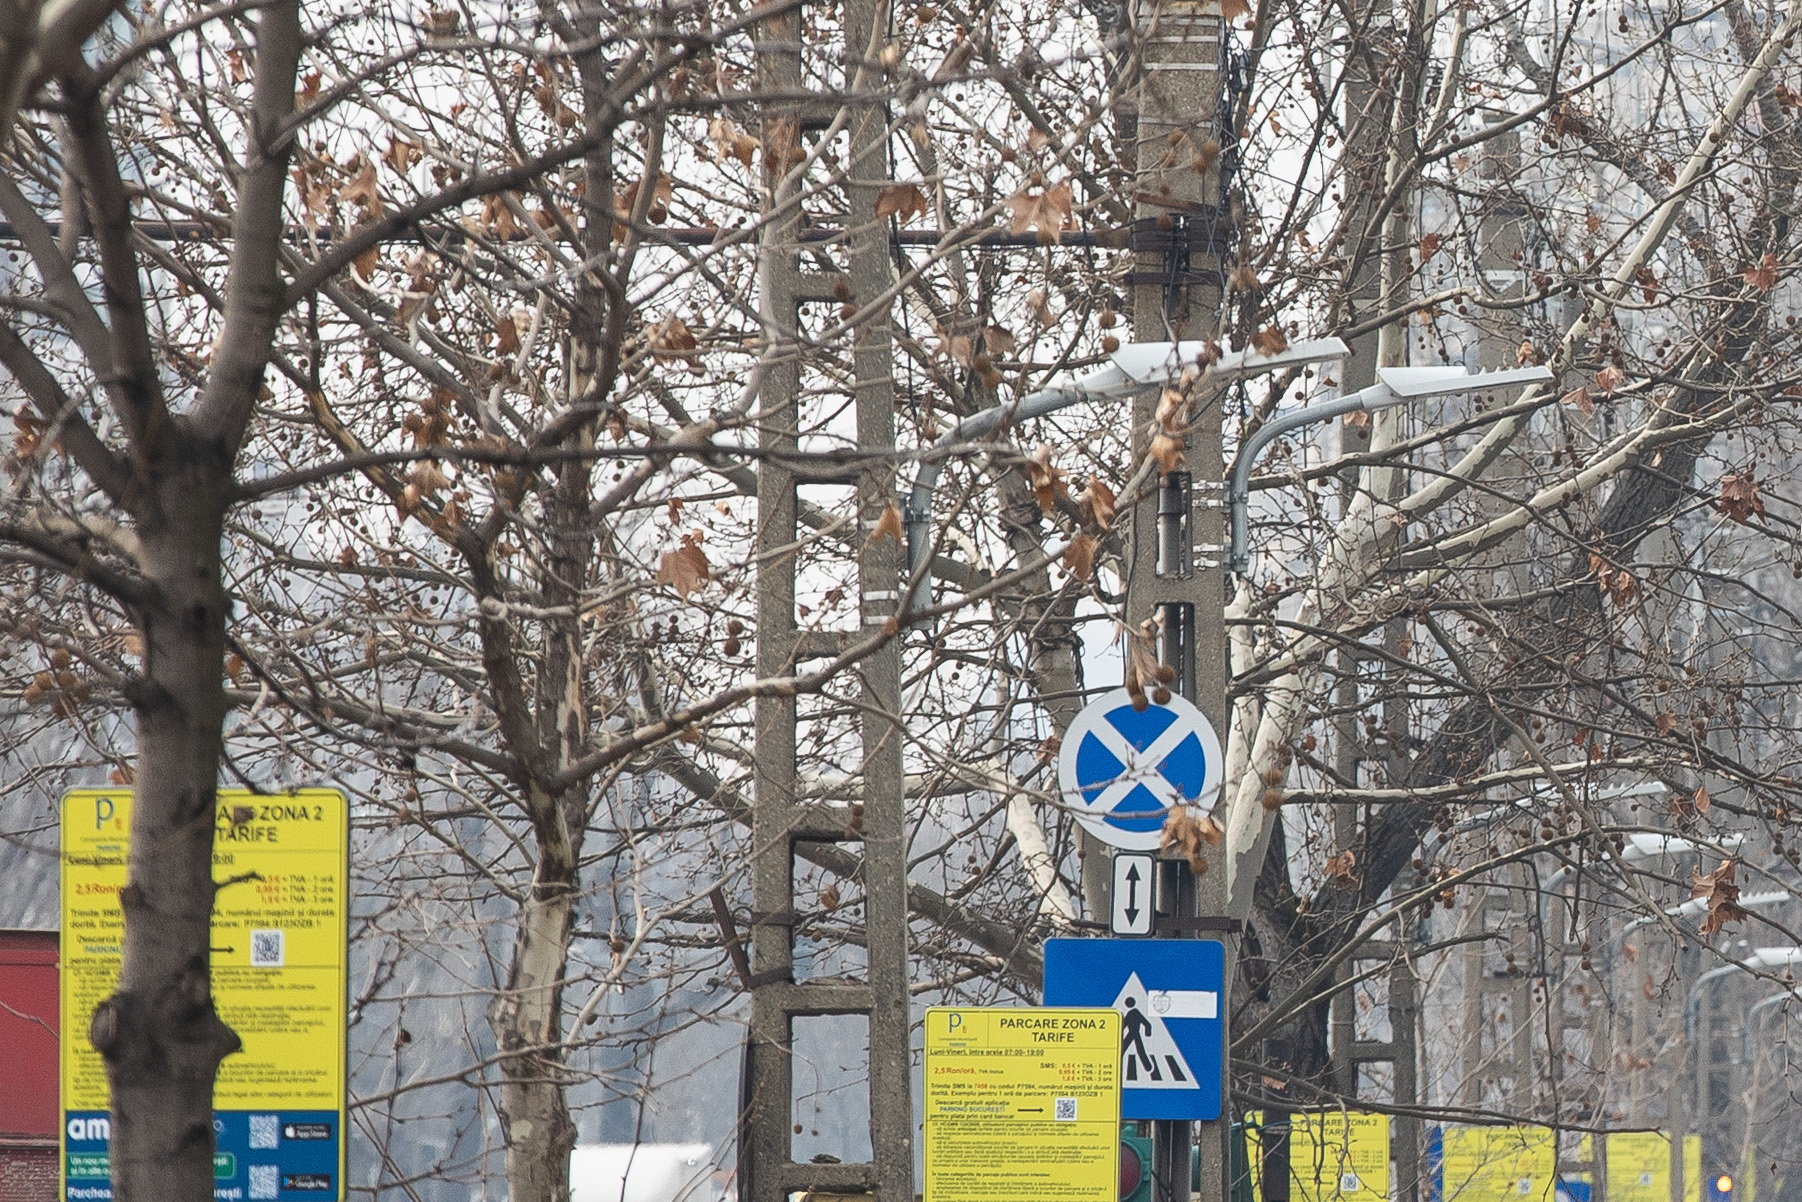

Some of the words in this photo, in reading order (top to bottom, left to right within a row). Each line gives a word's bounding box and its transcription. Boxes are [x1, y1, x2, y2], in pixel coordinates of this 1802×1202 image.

[260, 805, 309, 821] ZONA
[313, 805, 322, 821] 2
[216, 826, 278, 842] TARIFE
[1000, 1018, 1058, 1029] PARCARE
[1062, 1018, 1097, 1030] ZONA
[1098, 1019, 1106, 1030] 2
[1032, 1032, 1075, 1043] TARIFE
[67, 1186, 112, 1199] Parchea
